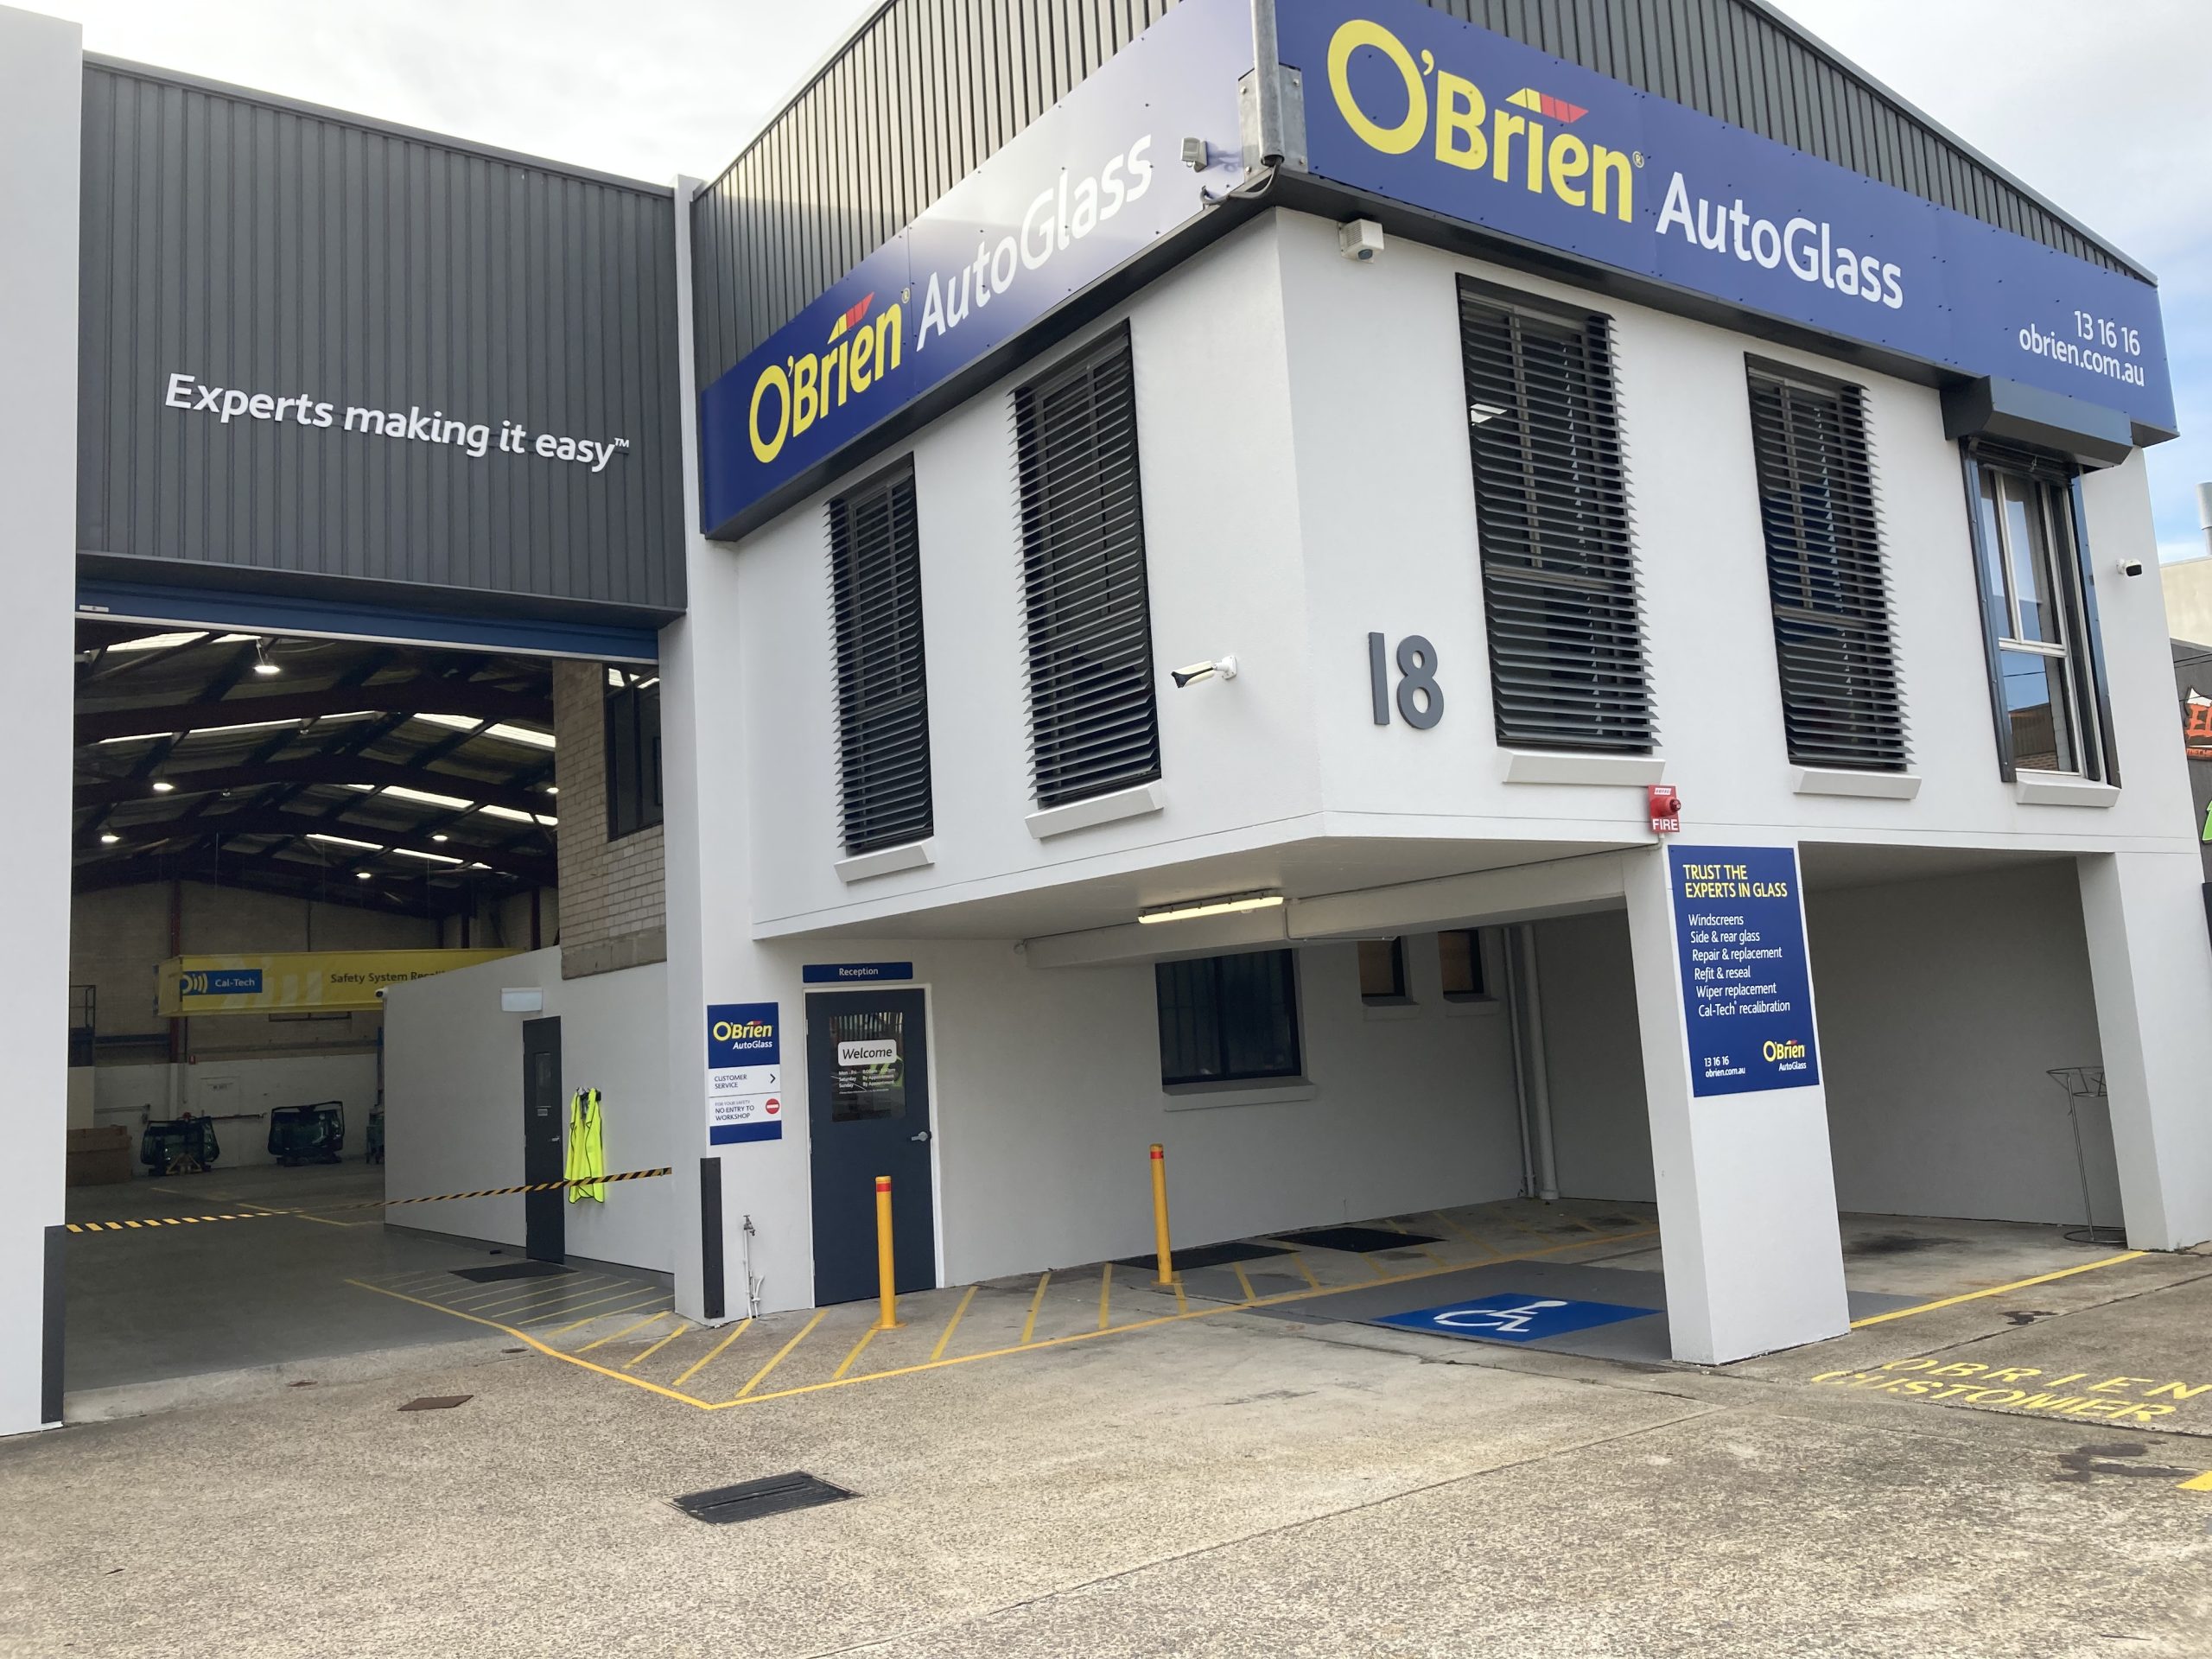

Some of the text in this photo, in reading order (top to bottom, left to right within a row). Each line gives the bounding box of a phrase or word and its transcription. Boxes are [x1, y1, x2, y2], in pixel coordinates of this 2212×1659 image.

[916, 134, 1153, 353] AutoGlass
[1656, 172, 1904, 309] AutoGlass
[2074, 310, 2140, 356] 13 16 16
[2019, 323, 2145, 387] obrien.com.au
[164, 372, 334, 424] Experts
[344, 406, 490, 457] making
[499, 420, 525, 453] it
[1369, 632, 1444, 730] 18
[1652, 818, 1679, 831] FIRE
[1682, 864, 1748, 880] TRUST THE
[1685, 882, 1788, 898] EXPERTS IN GLASS
[1688, 913, 1745, 926] Windscreens
[1690, 929, 1761, 945] Side & rear glass
[1692, 946, 1783, 964] Repair & replacement
[214, 977, 256, 988] Cal-Tech
[330, 973, 365, 984] Safety
[368, 971, 408, 983] System
[838, 967, 879, 977] Reception
[1694, 964, 1751, 983] Refit & reseal
[1695, 982, 1777, 1001] Wiper replacement
[1739, 999, 1790, 1014] recalibration
[713, 1020, 772, 1041] O'Brien
[732, 1039, 772, 1050] AutoGlass
[842, 1047, 893, 1059] Welcome
[1763, 1039, 1806, 1063] O'Brien
[1704, 1055, 1730, 1067] 13 16 16
[1778, 1061, 1807, 1071] AutoGlass
[1705, 1066, 1745, 1078] obrien.com.au
[1881, 1357, 2212, 1400] OBRIEN
